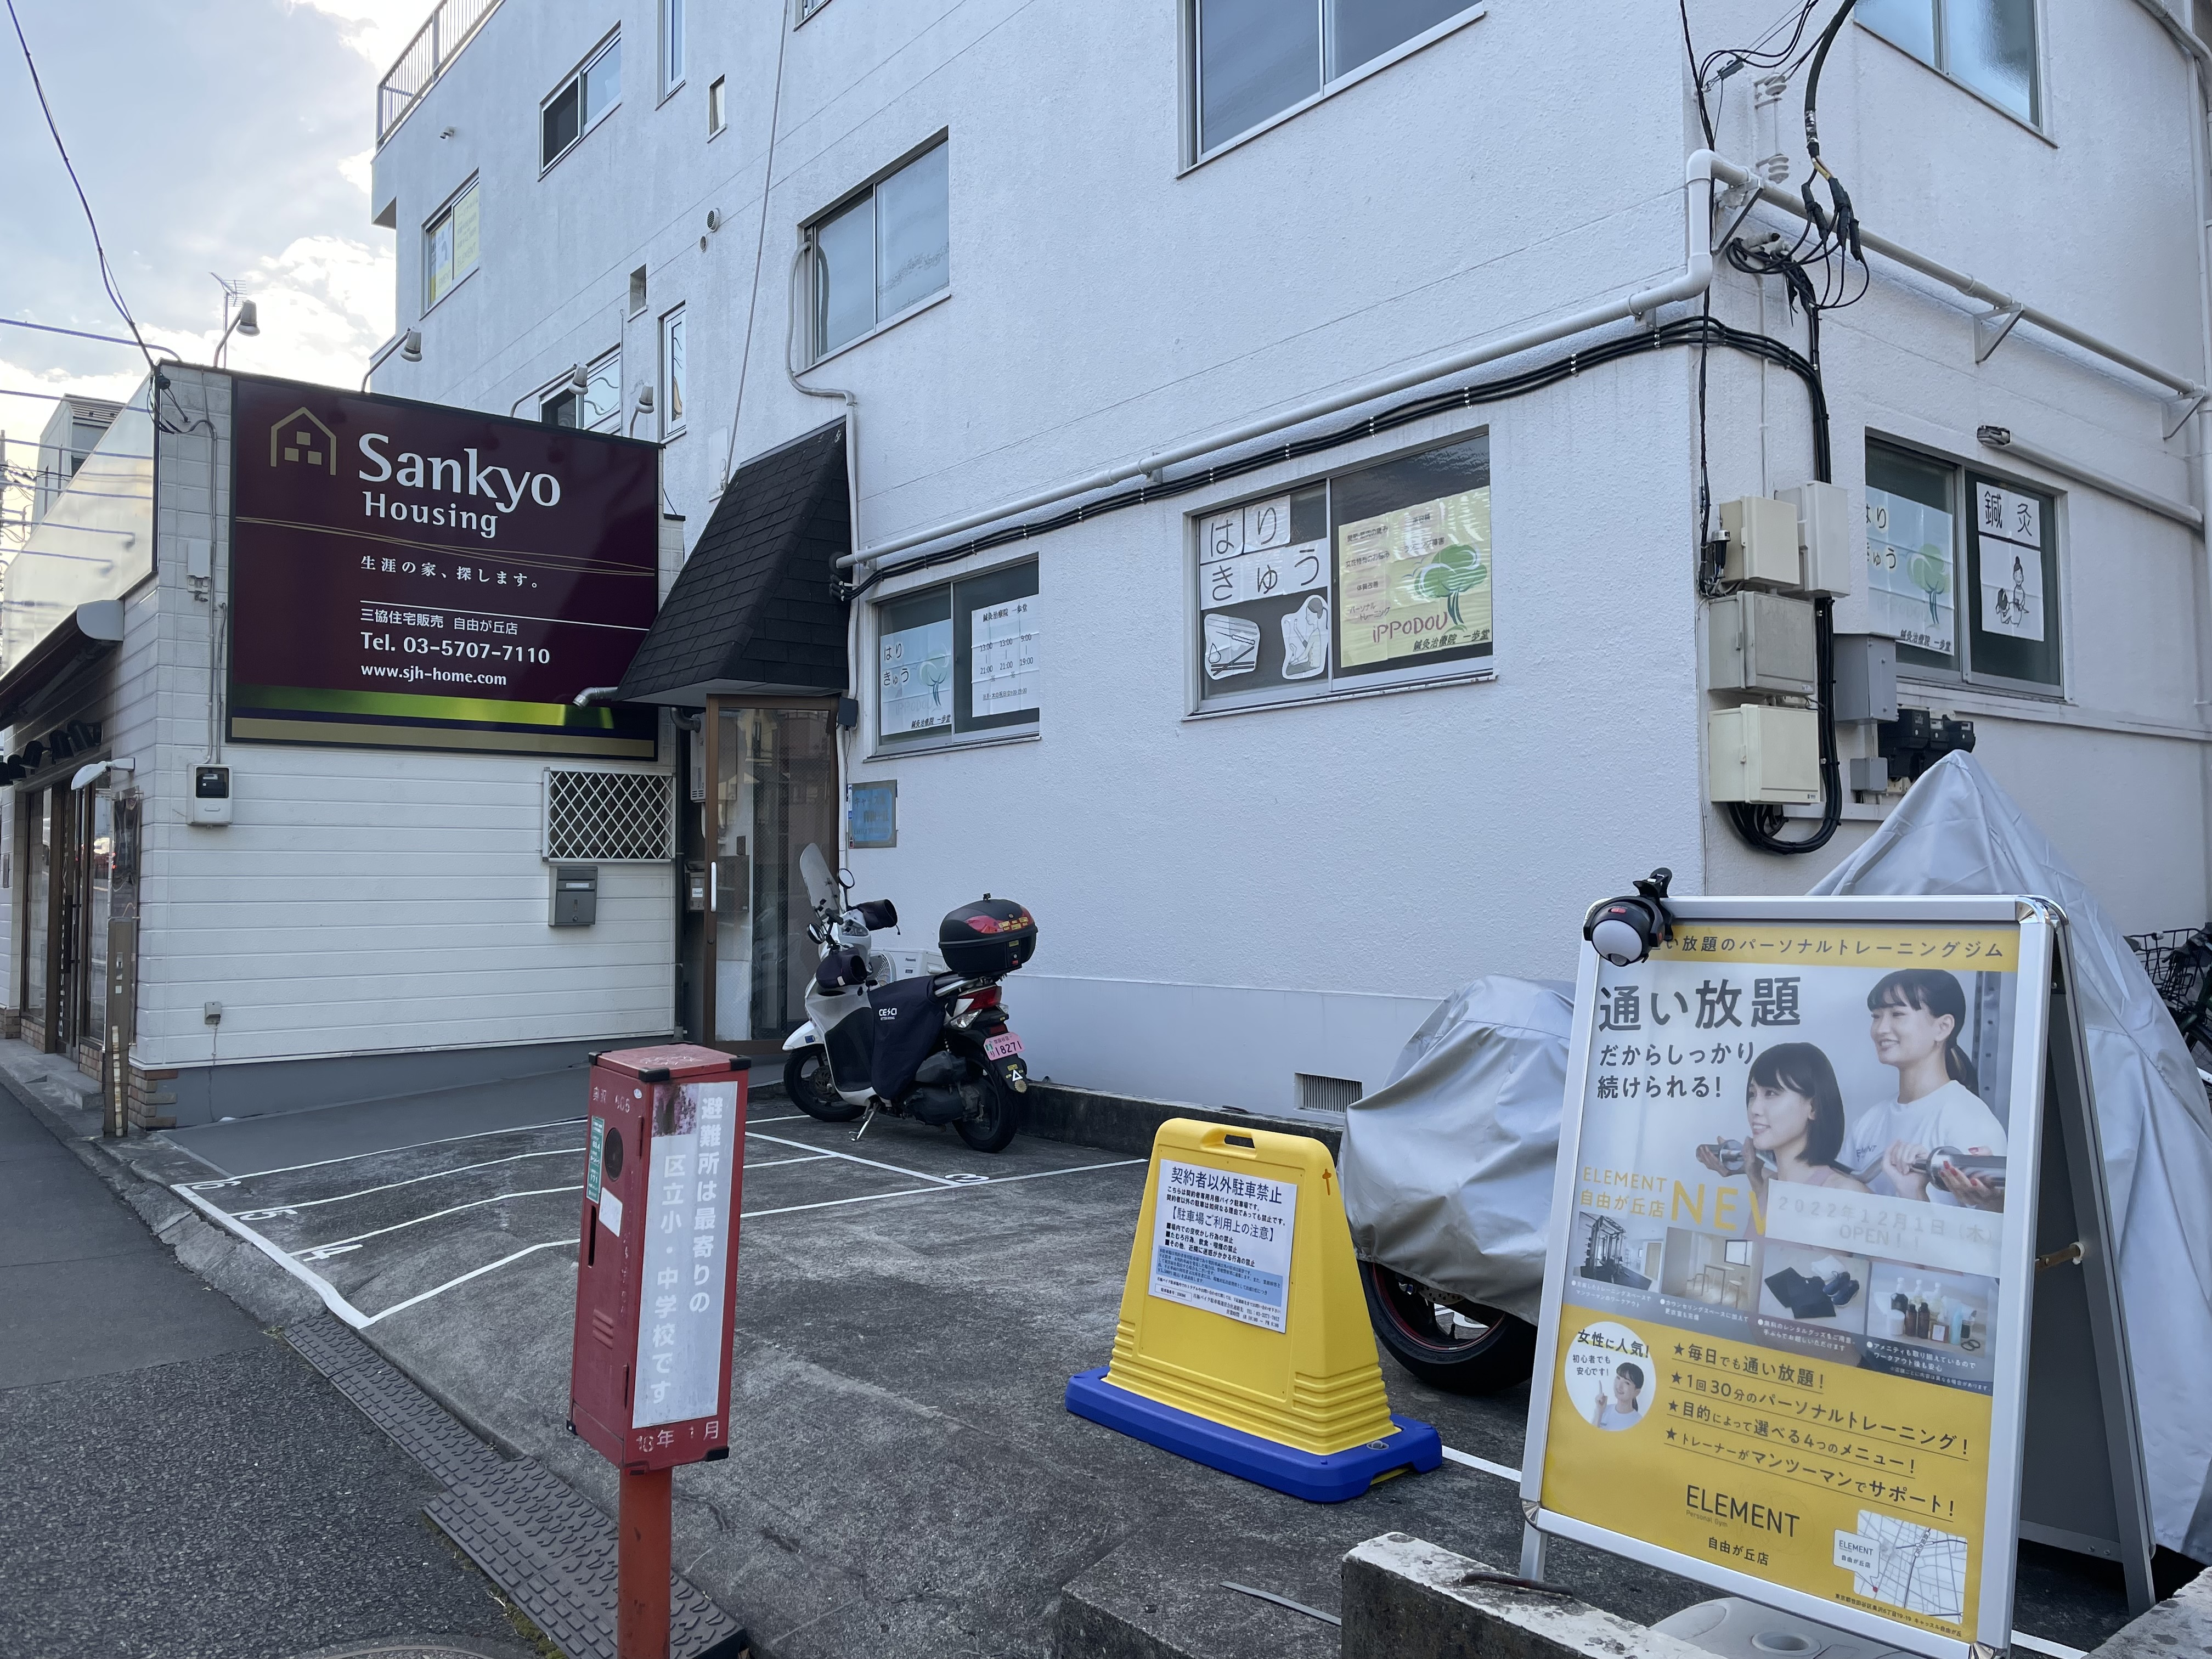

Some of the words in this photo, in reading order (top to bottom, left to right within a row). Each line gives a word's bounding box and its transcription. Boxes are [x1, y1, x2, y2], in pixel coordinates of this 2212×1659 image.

[358, 432, 561, 513] Sankyo
[362, 491, 498, 539] Housing
[1984, 490, 2033, 538] 鍼灸
[1210, 507, 1278, 557] はり
[360, 555, 540, 589] 生涯の家、探します。
[1212, 549, 1319, 602] きゅう
[360, 608, 444, 629] 三協住宅販売
[453, 616, 518, 636] 自由が丘店
[360, 631, 396, 652] Tel.
[403, 636, 550, 664] 03-5707-7110
[884, 642, 902, 662] はり
[1000, 637, 1013, 648] 13:00
[1020, 633, 1032, 642] 9:00
[360, 664, 506, 686] www.sjh-home.com
[1000, 661, 1013, 670] 21:00
[1019, 657, 1034, 667] 19:00
[1651, 934, 2004, 959] い放題のパーソナルトレーニングジム
[1598, 977, 1801, 1032] 通い放題
[995, 1041, 1022, 1056] 18271
[1600, 1042, 1756, 1066] だからしっかり
[1597, 1075, 1722, 1099] 続けられる!
[1171, 1166, 1282, 1204] 契約者以外駐車禁止
[1583, 1166, 1667, 1192] ELEMENT
[689, 1098, 723, 1313] 避難所は最寄りの
[1581, 1189, 1664, 1218] 自由が丘店
[1172, 1206, 1274, 1242] 【駐車場ご利用上の注意】
[650, 1155, 686, 1405] 区立小・中学校です
[1577, 1329, 1649, 1358] 女性に人気!
[1573, 1354, 1611, 1364] 初心者でも
[1686, 1485, 1800, 1538] ELEMENT
[1708, 1537, 1769, 1566] 自由が丘店
[1839, 1539, 1874, 1556] ELEMENT
